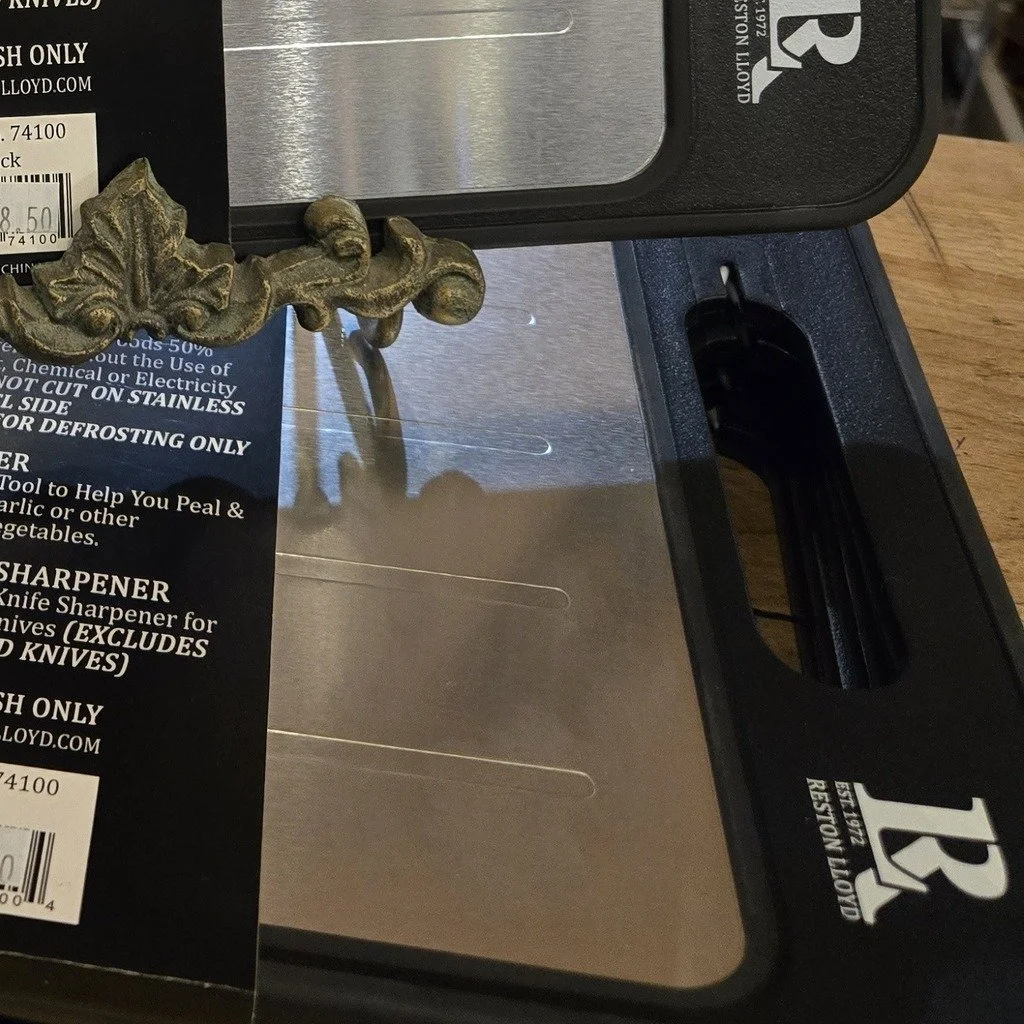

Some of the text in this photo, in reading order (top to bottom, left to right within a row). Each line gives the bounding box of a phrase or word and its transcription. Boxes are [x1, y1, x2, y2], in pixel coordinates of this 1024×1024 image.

[755, 8, 766, 37] 1972
[29, 42, 89, 66] ONLY
[736, 53, 750, 104] LLOYD
[10, 123, 66, 141] 74100
[132, 352, 164, 369] the
[170, 356, 206, 374] Use
[168, 338, 214, 358] 50%
[12, 357, 102, 382] Chemical
[135, 371, 238, 400] Electricity
[17, 396, 73, 416] SIDE
[41, 380, 89, 398] CUT
[90, 385, 125, 403] ON
[126, 389, 246, 416] STAINLESS
[38, 417, 185, 449] DEFROSTING
[189, 435, 252, 456] ONLY
[74, 482, 124, 509] Help
[130, 489, 169, 511] You
[176, 494, 221, 517] Peal
[79, 507, 140, 528] other
[55, 595, 178, 628] Sharpener
[183, 611, 218, 634] for
[62, 620, 210, 660] (EXCLUDES
[18, 641, 130, 678] KNIVES)
[32, 697, 104, 726] ONLY
